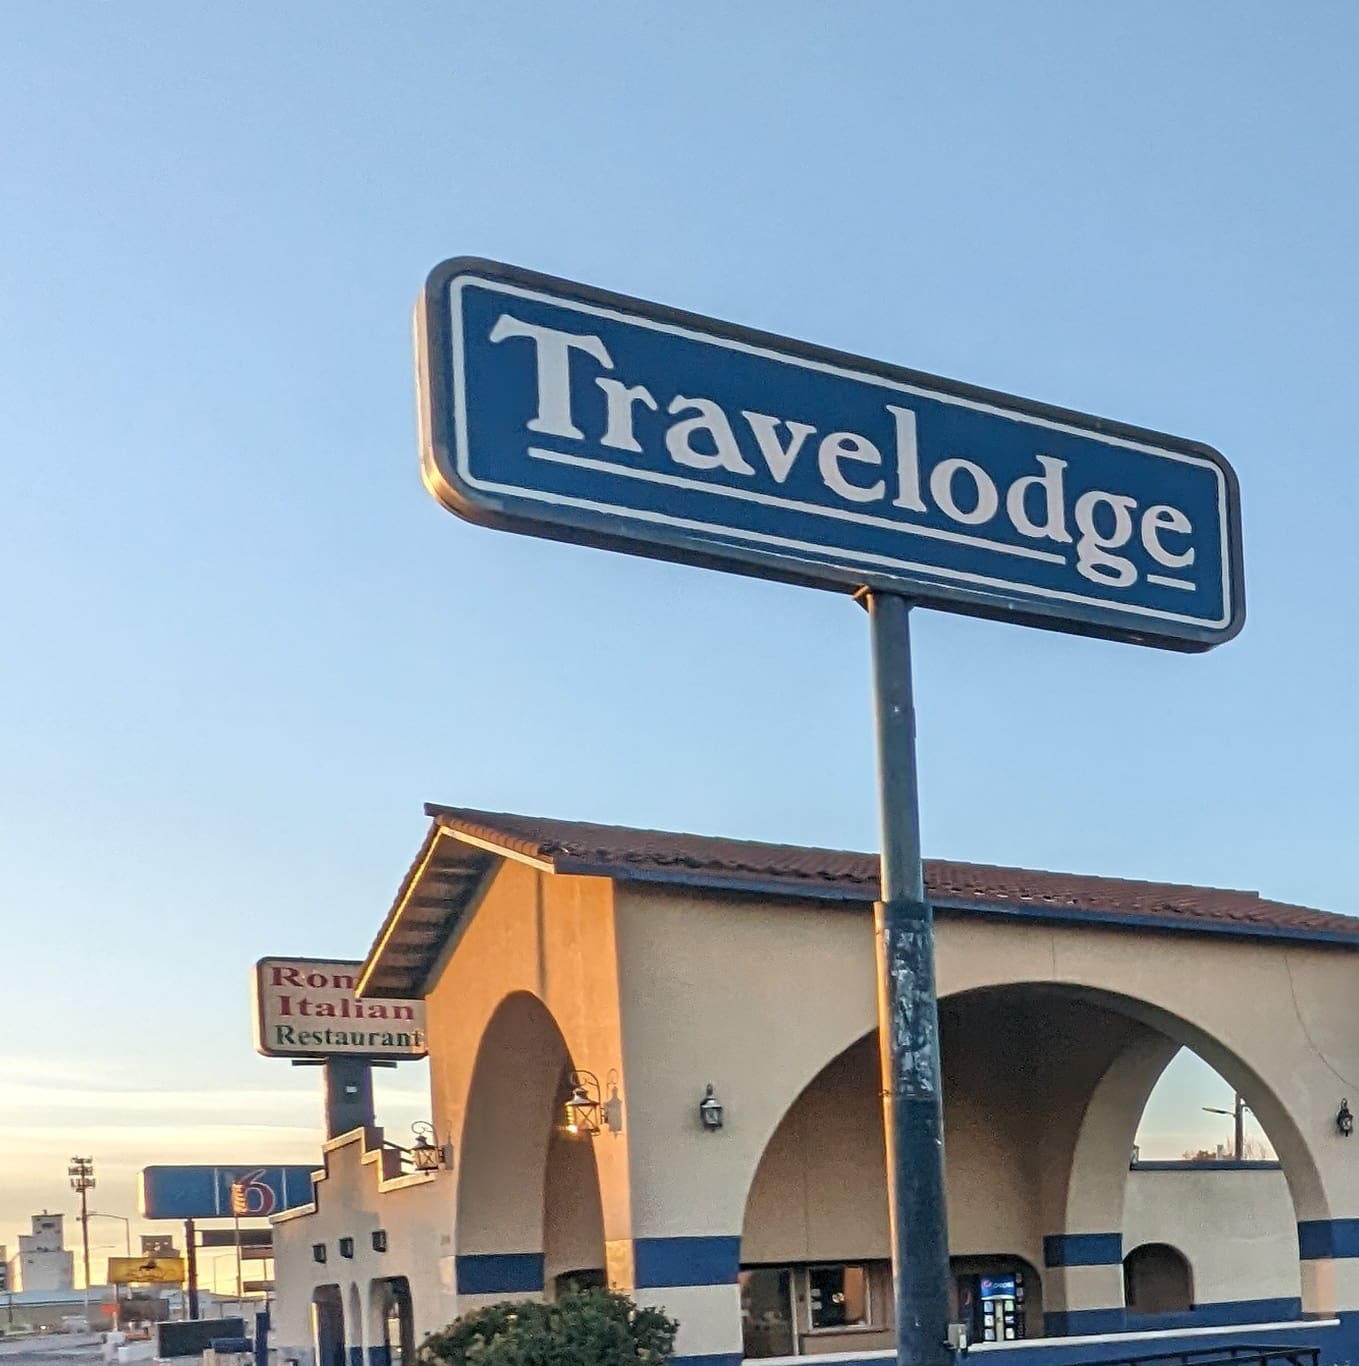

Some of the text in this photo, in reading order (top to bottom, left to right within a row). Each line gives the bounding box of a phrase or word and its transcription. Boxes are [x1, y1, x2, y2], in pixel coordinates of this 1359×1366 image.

[489, 314, 1196, 588] Travelodge
[278, 995, 415, 1020] Italian
[275, 1025, 424, 1047] Restaurant
[233, 1168, 276, 1215] 6
